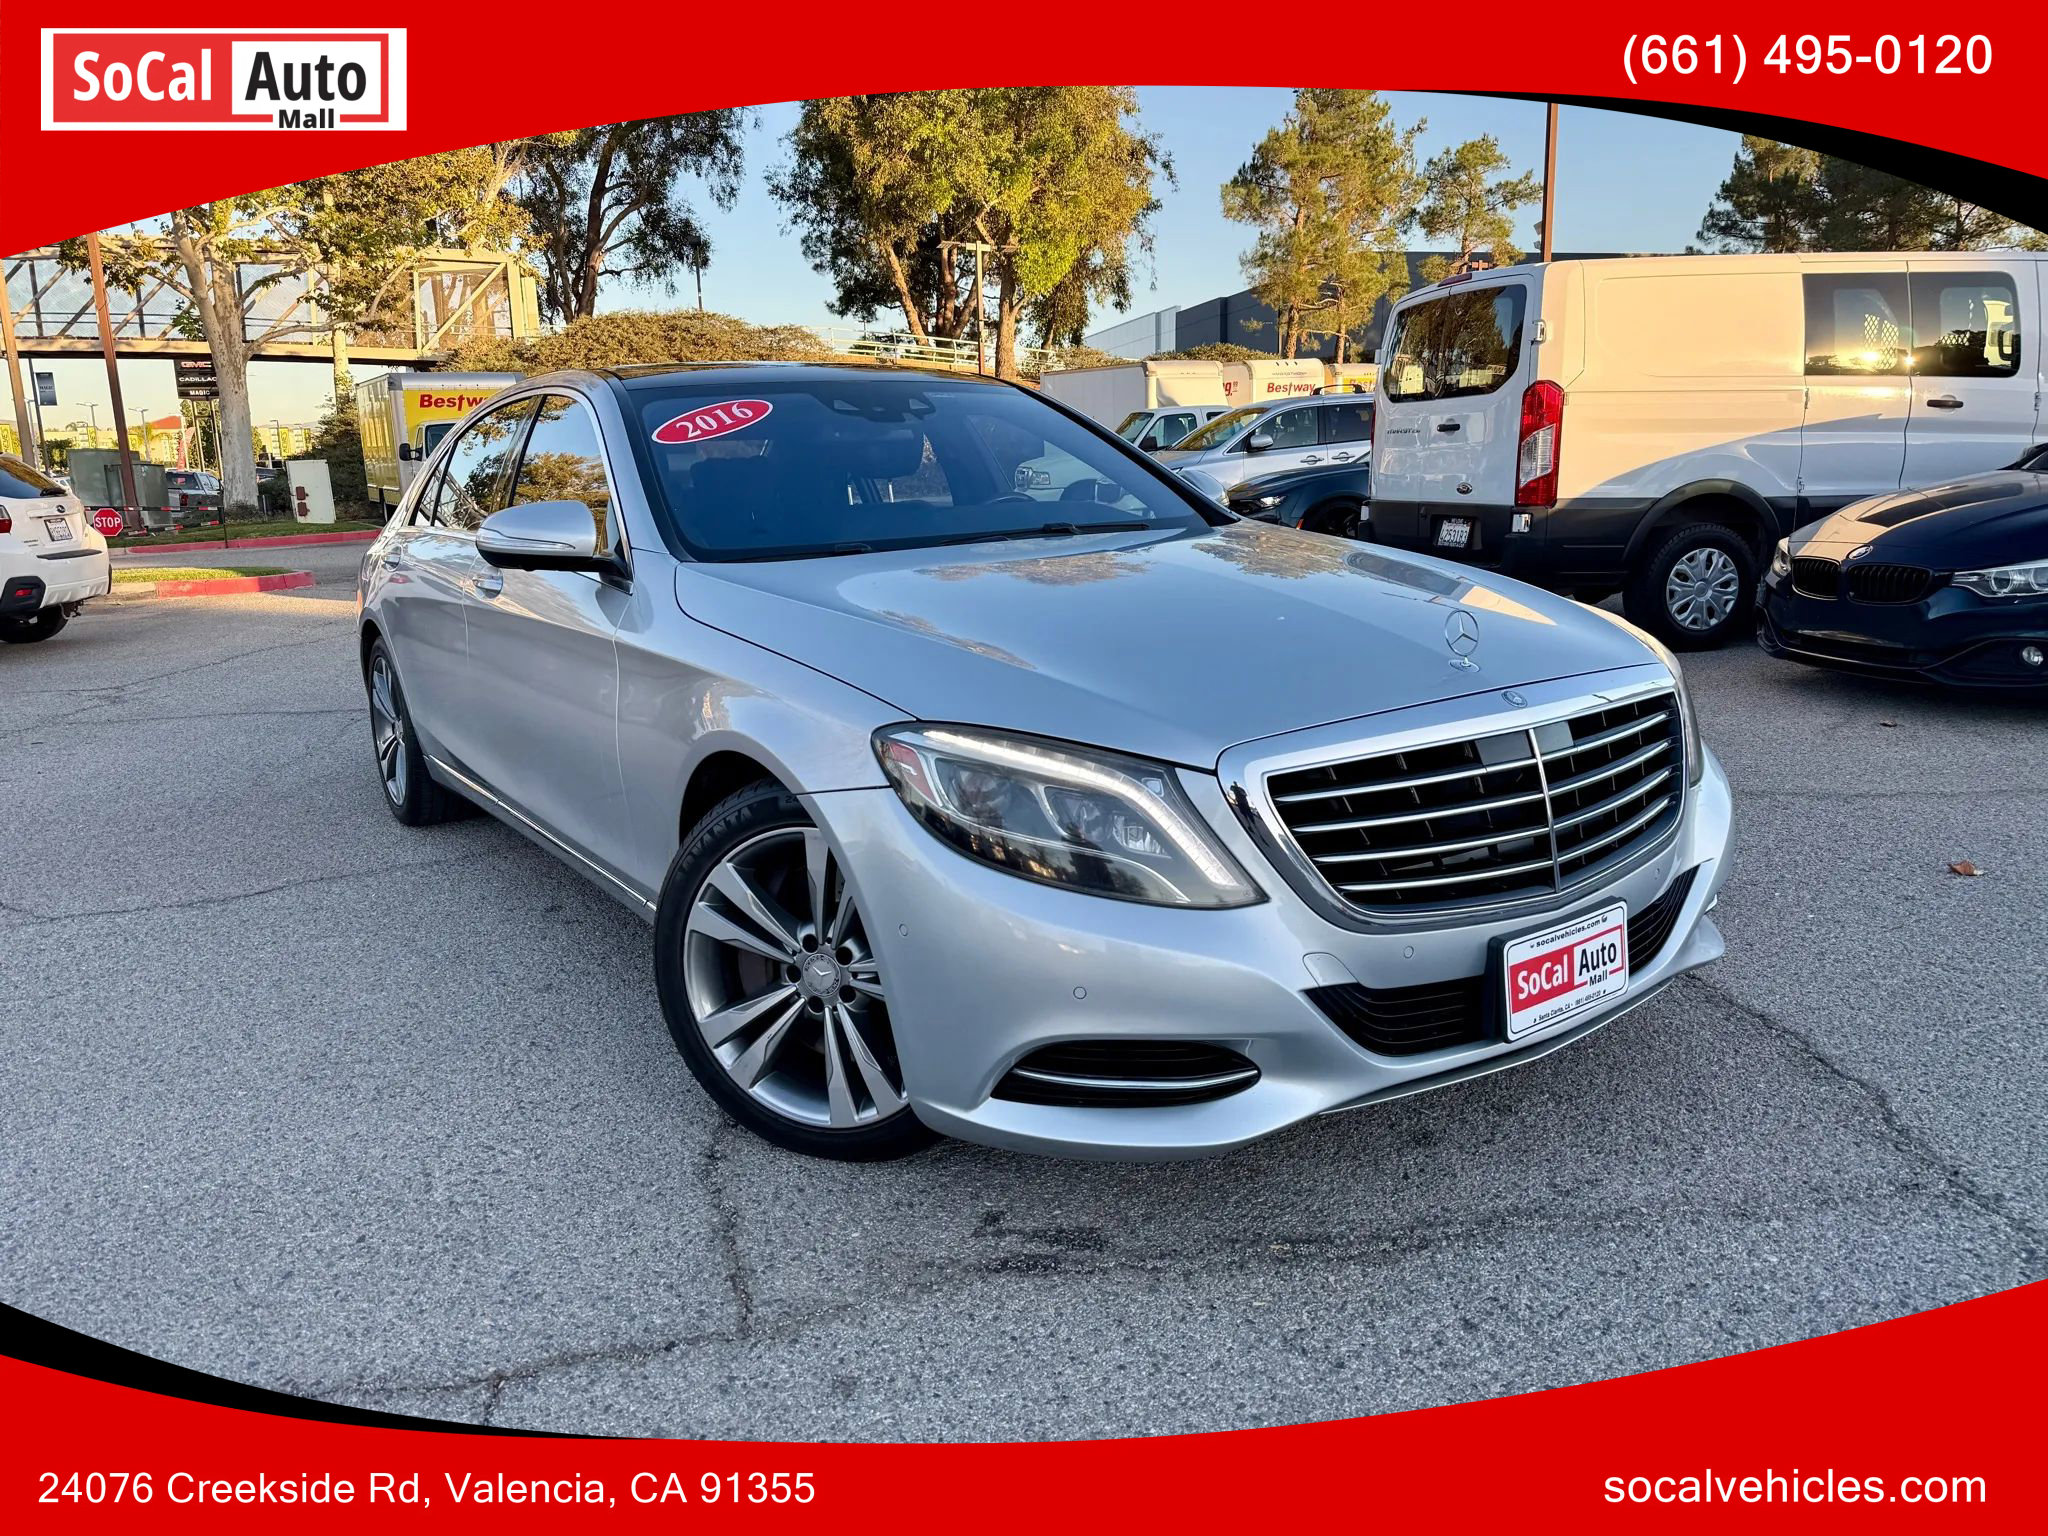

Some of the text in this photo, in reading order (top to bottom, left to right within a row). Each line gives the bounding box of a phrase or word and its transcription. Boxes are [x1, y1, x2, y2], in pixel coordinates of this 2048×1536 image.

[1267, 383, 1316, 396] Bestway
[419, 393, 489, 412] Bestw
[675, 402, 754, 439] 2016
[95, 516, 121, 530] STOP
[1536, 920, 1600, 947] socalvehicles.com
[1517, 942, 1617, 1001] SoCal Auto
[1589, 969, 1608, 987] Mall
